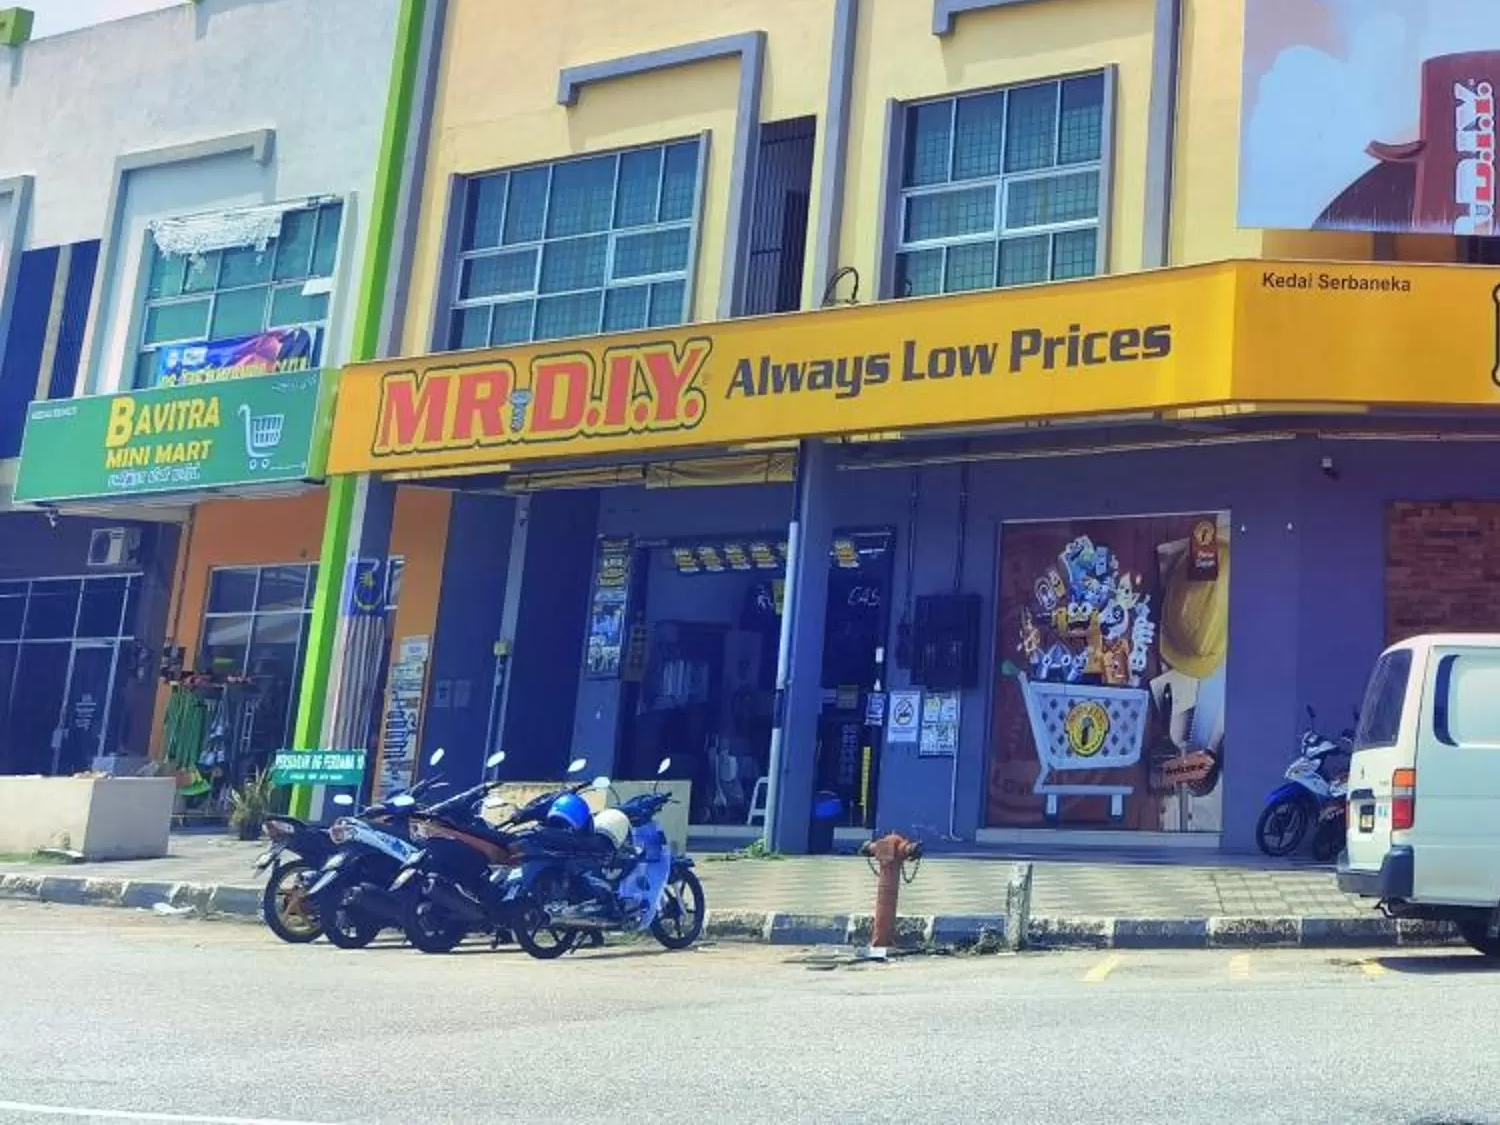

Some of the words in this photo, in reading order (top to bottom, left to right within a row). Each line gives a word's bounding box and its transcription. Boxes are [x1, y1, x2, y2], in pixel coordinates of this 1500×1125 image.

[1262, 272, 1313, 289] Kedai
[1317, 274, 1411, 292] Serbaneka
[725, 353, 891, 400] Always
[902, 340, 998, 382] Low
[1009, 324, 1172, 373] Prices
[105, 396, 221, 447] BAVITRA
[105, 445, 151, 469] MINI
[155, 439, 213, 464] MART
